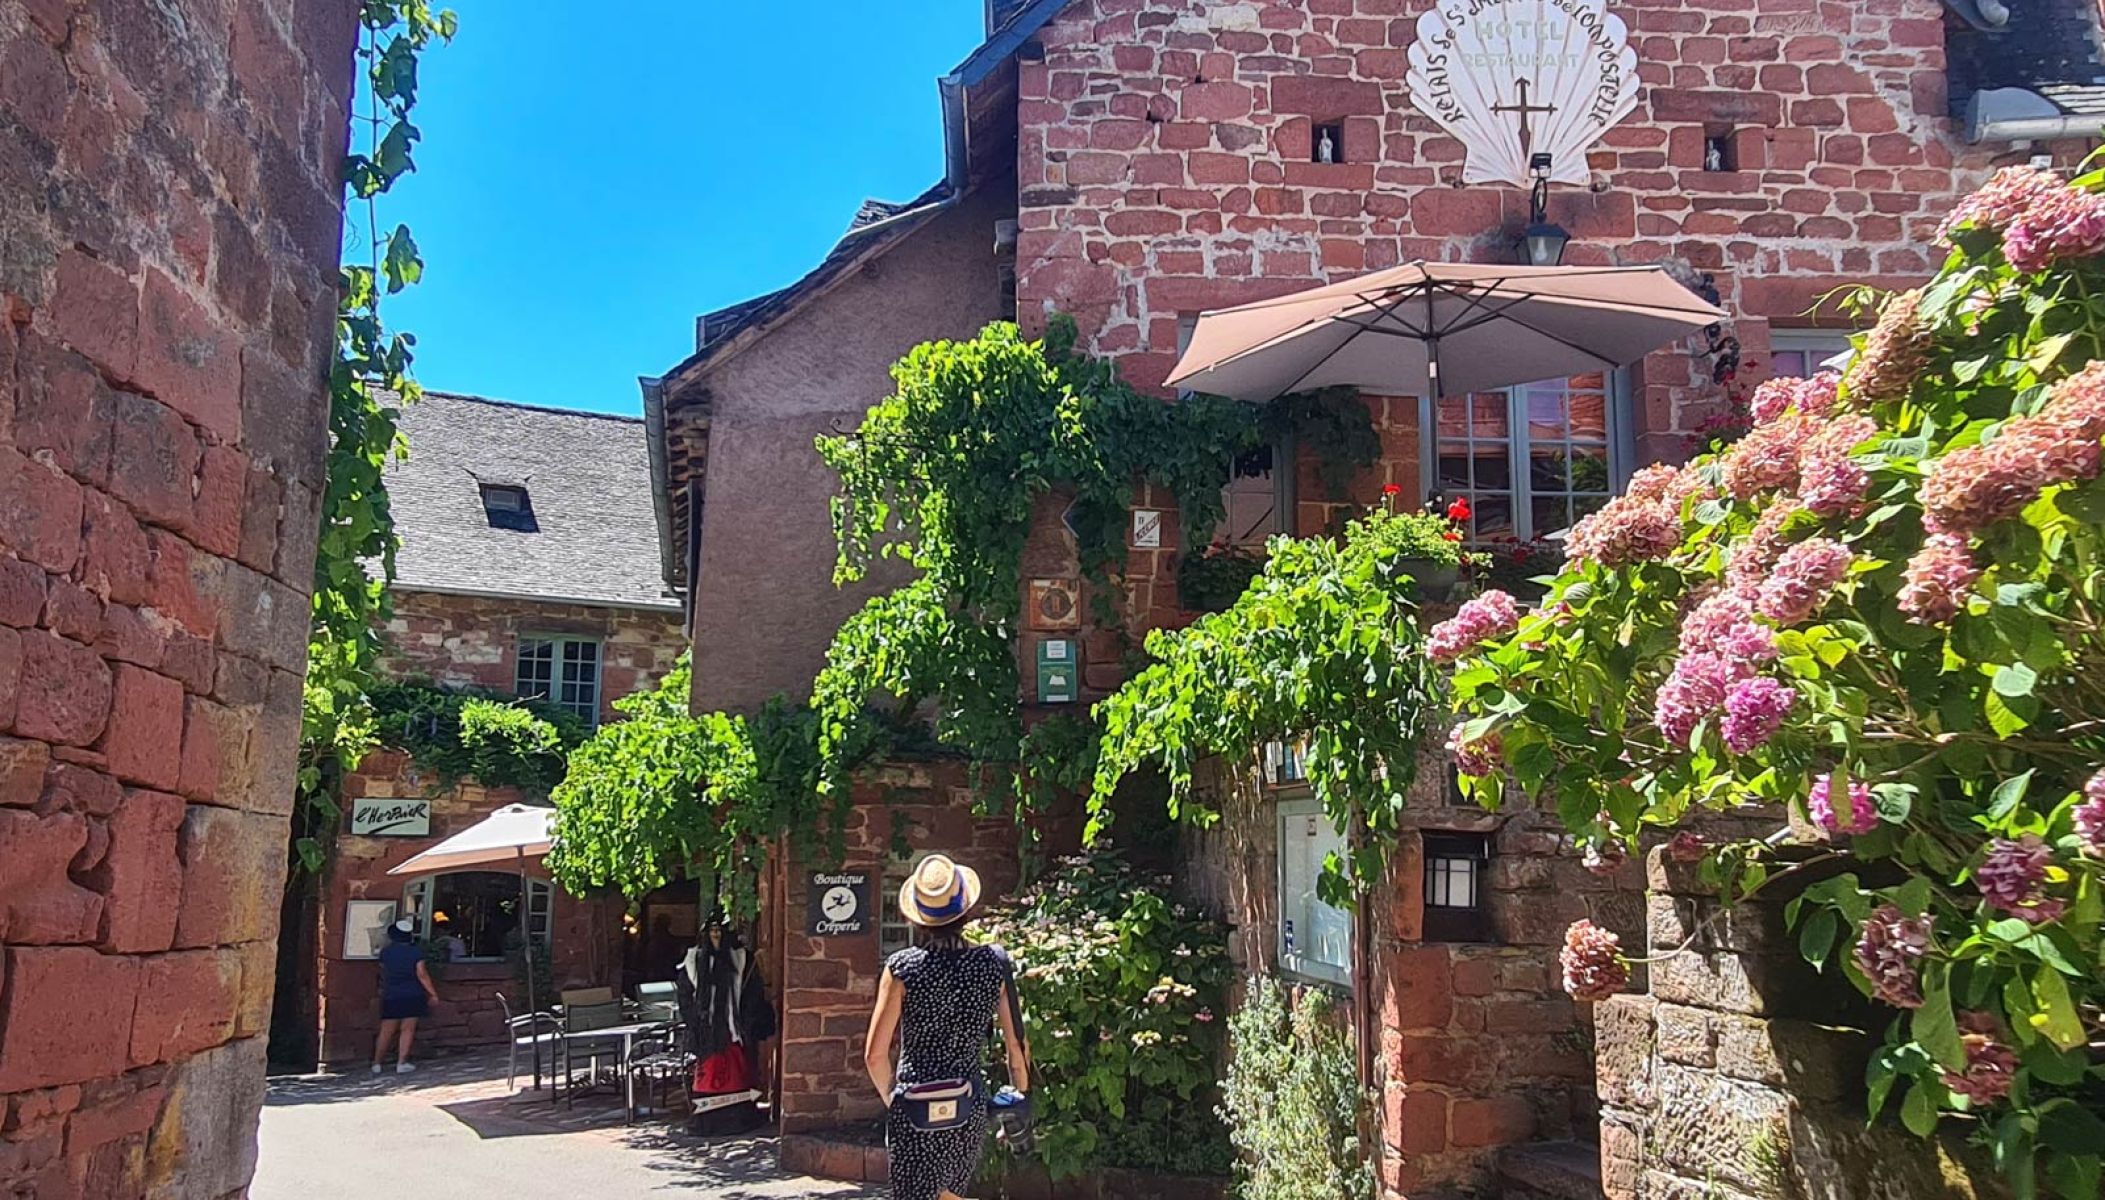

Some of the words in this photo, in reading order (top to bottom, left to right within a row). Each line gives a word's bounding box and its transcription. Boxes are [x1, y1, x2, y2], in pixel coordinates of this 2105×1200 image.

[1475, 20, 1565, 40] HOTEL
[1461, 53, 1580, 67] RESTAURANT
[813, 872, 865, 887] Boutique
[816, 919, 860, 935] Crêperie
